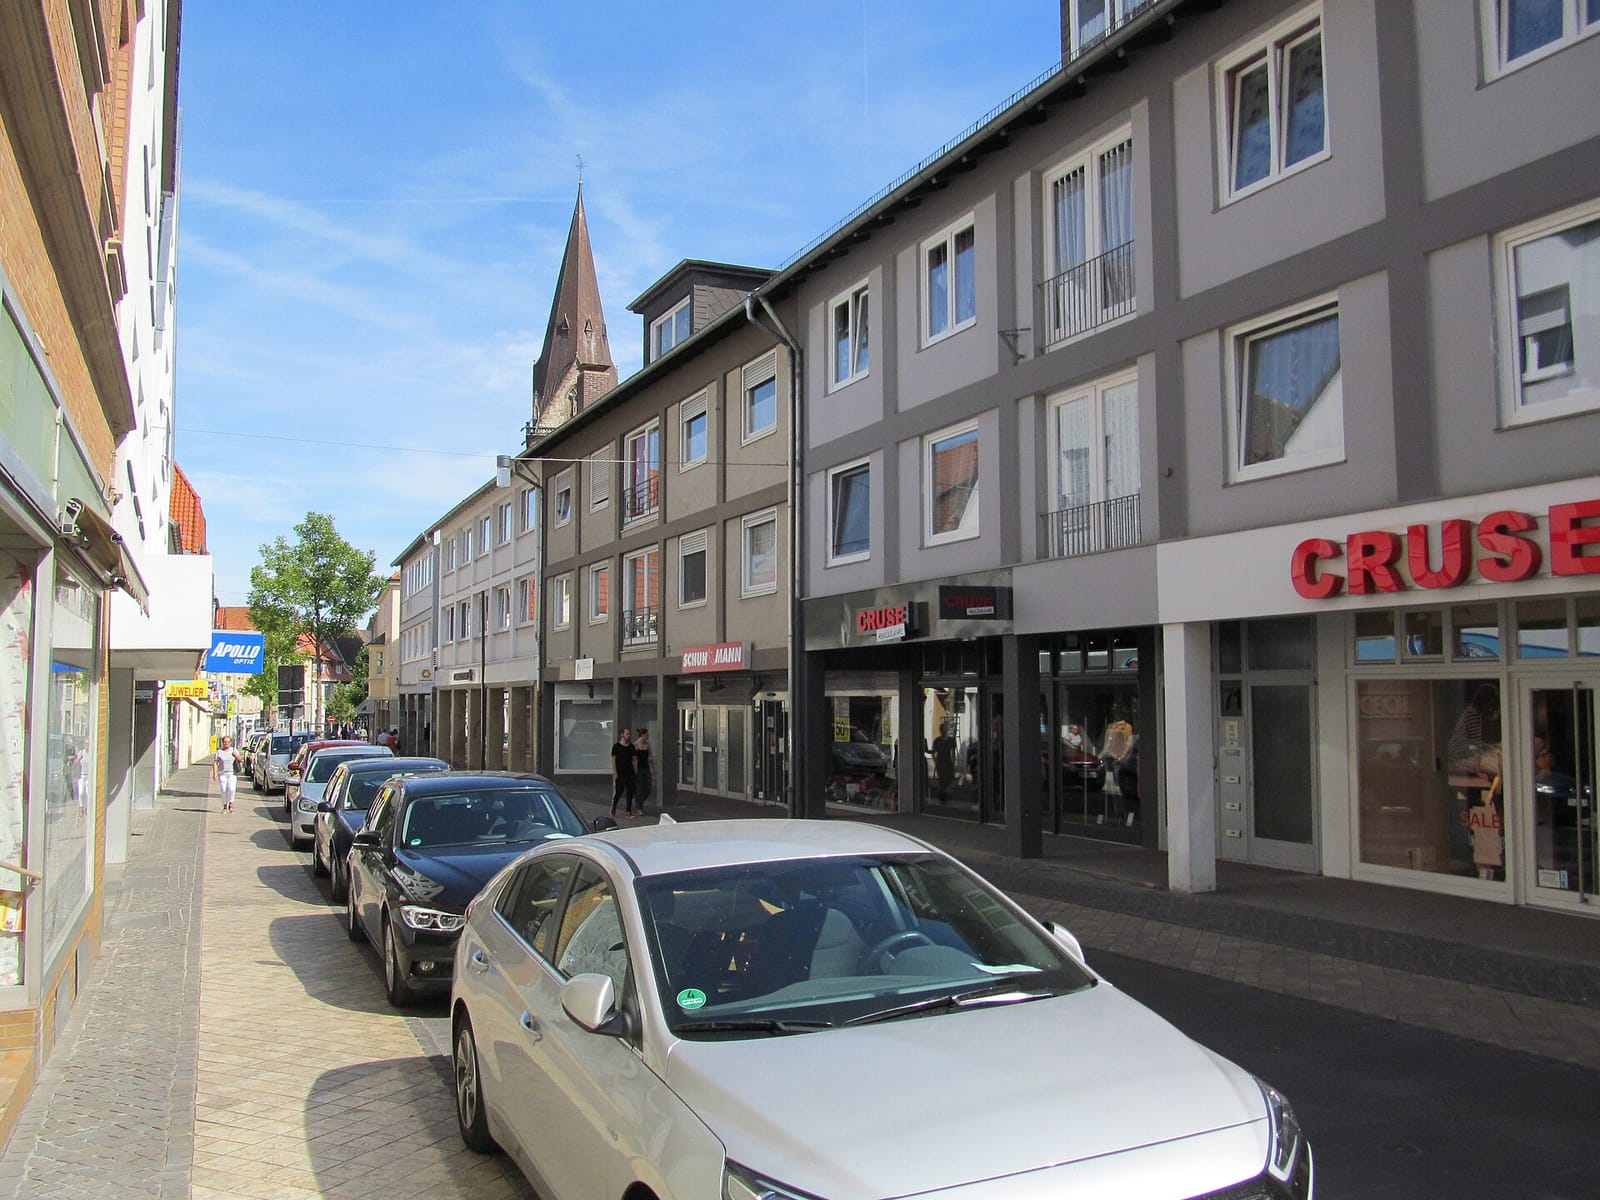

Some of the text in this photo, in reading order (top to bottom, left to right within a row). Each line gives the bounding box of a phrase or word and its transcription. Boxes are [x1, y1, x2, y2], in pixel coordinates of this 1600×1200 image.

[1290, 499, 1600, 599] CRUSE
[856, 604, 906, 632] CRUSE
[211, 642, 261, 658] APOLLO
[682, 646, 742, 667] SCHUH MANN
[168, 684, 204, 697] JUWELIER
[1459, 810, 1501, 828] SALE
